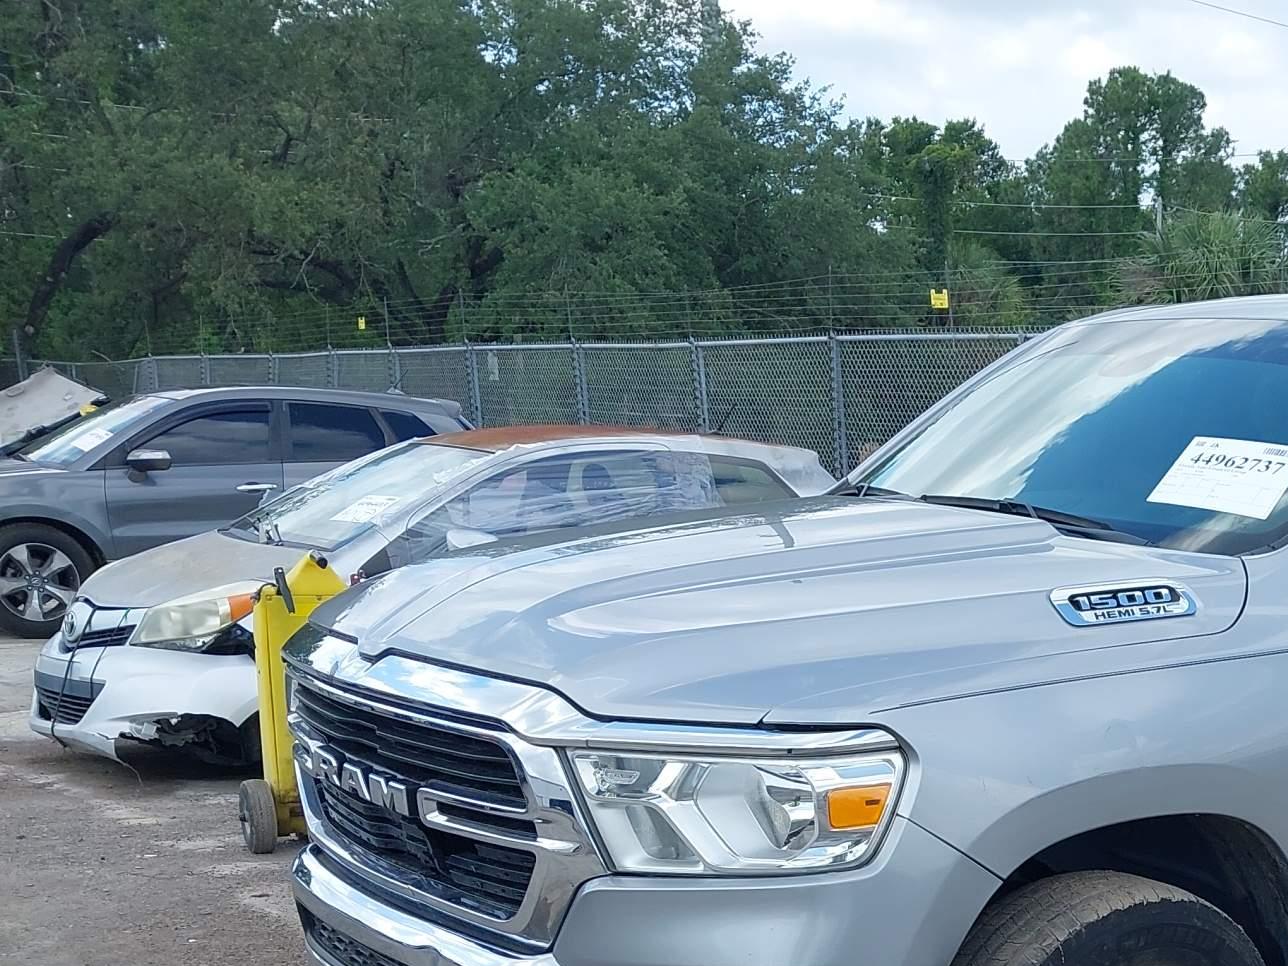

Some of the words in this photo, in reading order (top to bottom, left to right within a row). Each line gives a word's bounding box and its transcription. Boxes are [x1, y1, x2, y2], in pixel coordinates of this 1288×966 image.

[1190, 452, 1287, 475] 44962737
[1073, 588, 1172, 610] 1500
[1094, 608, 1135, 621] HEMI
[1140, 604, 1174, 616] 5.7L
[313, 743, 410, 817] RAM
